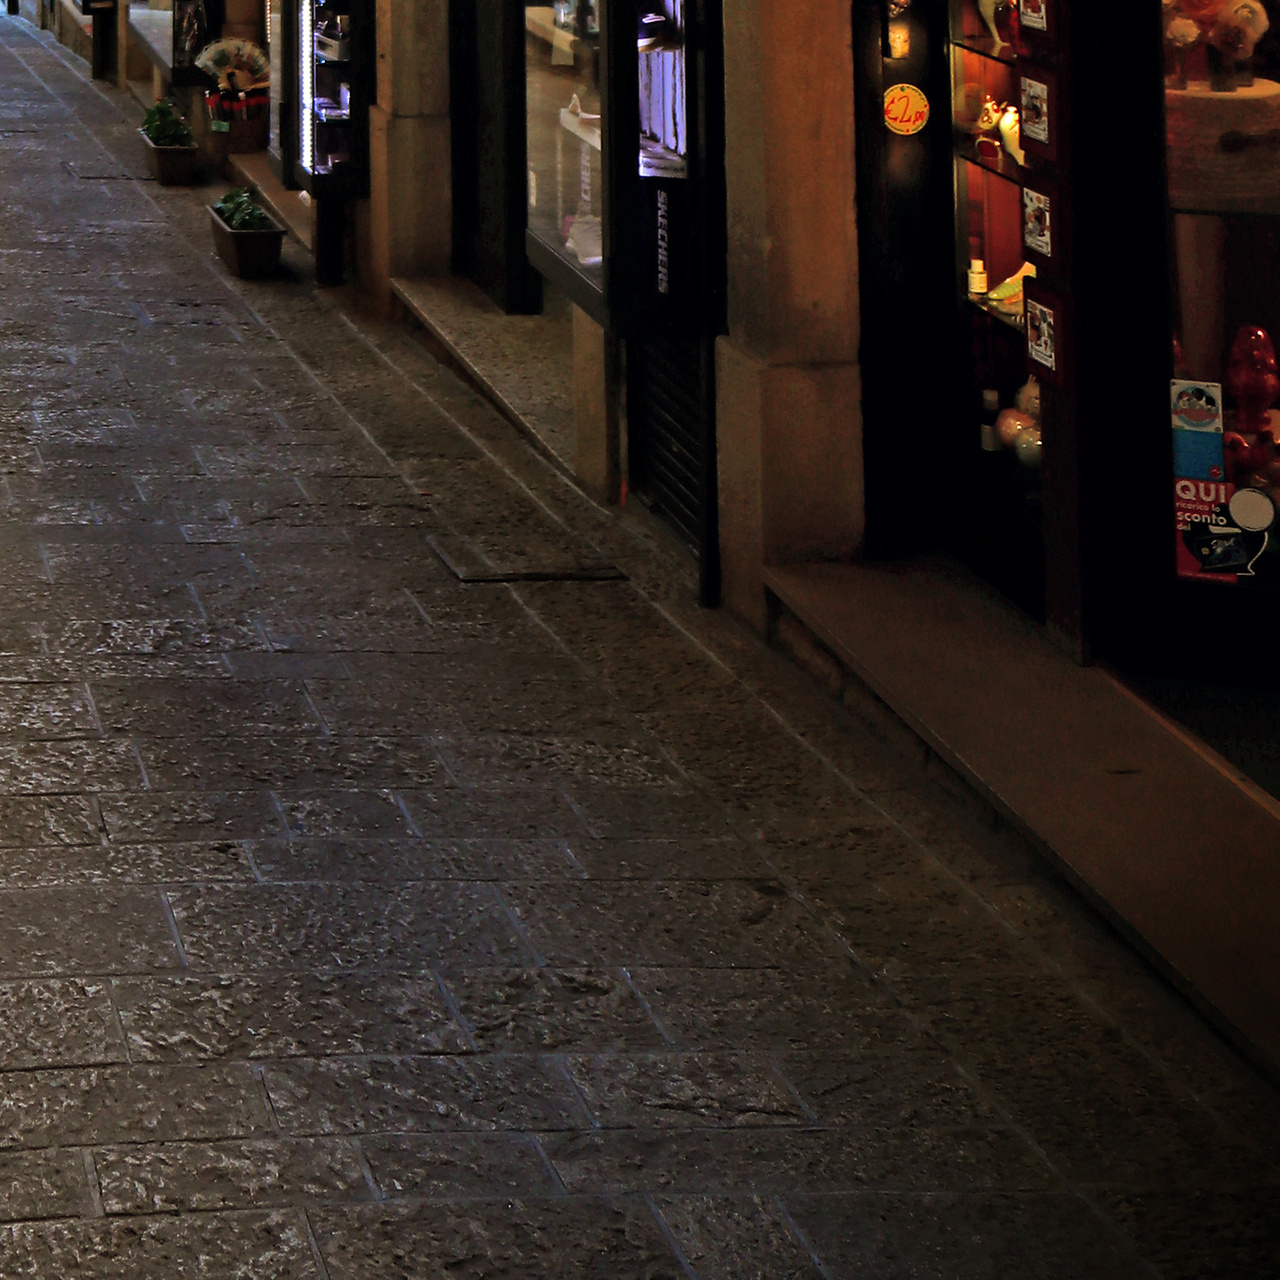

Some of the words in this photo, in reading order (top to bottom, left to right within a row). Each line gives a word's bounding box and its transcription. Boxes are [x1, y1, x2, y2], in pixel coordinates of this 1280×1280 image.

[884, 95, 926, 125] €2,00
[656, 188, 669, 295] SKECHERS
[1175, 479, 1226, 504] QUI
[1176, 511, 1228, 526] sconto
[1176, 521, 1192, 532] del
